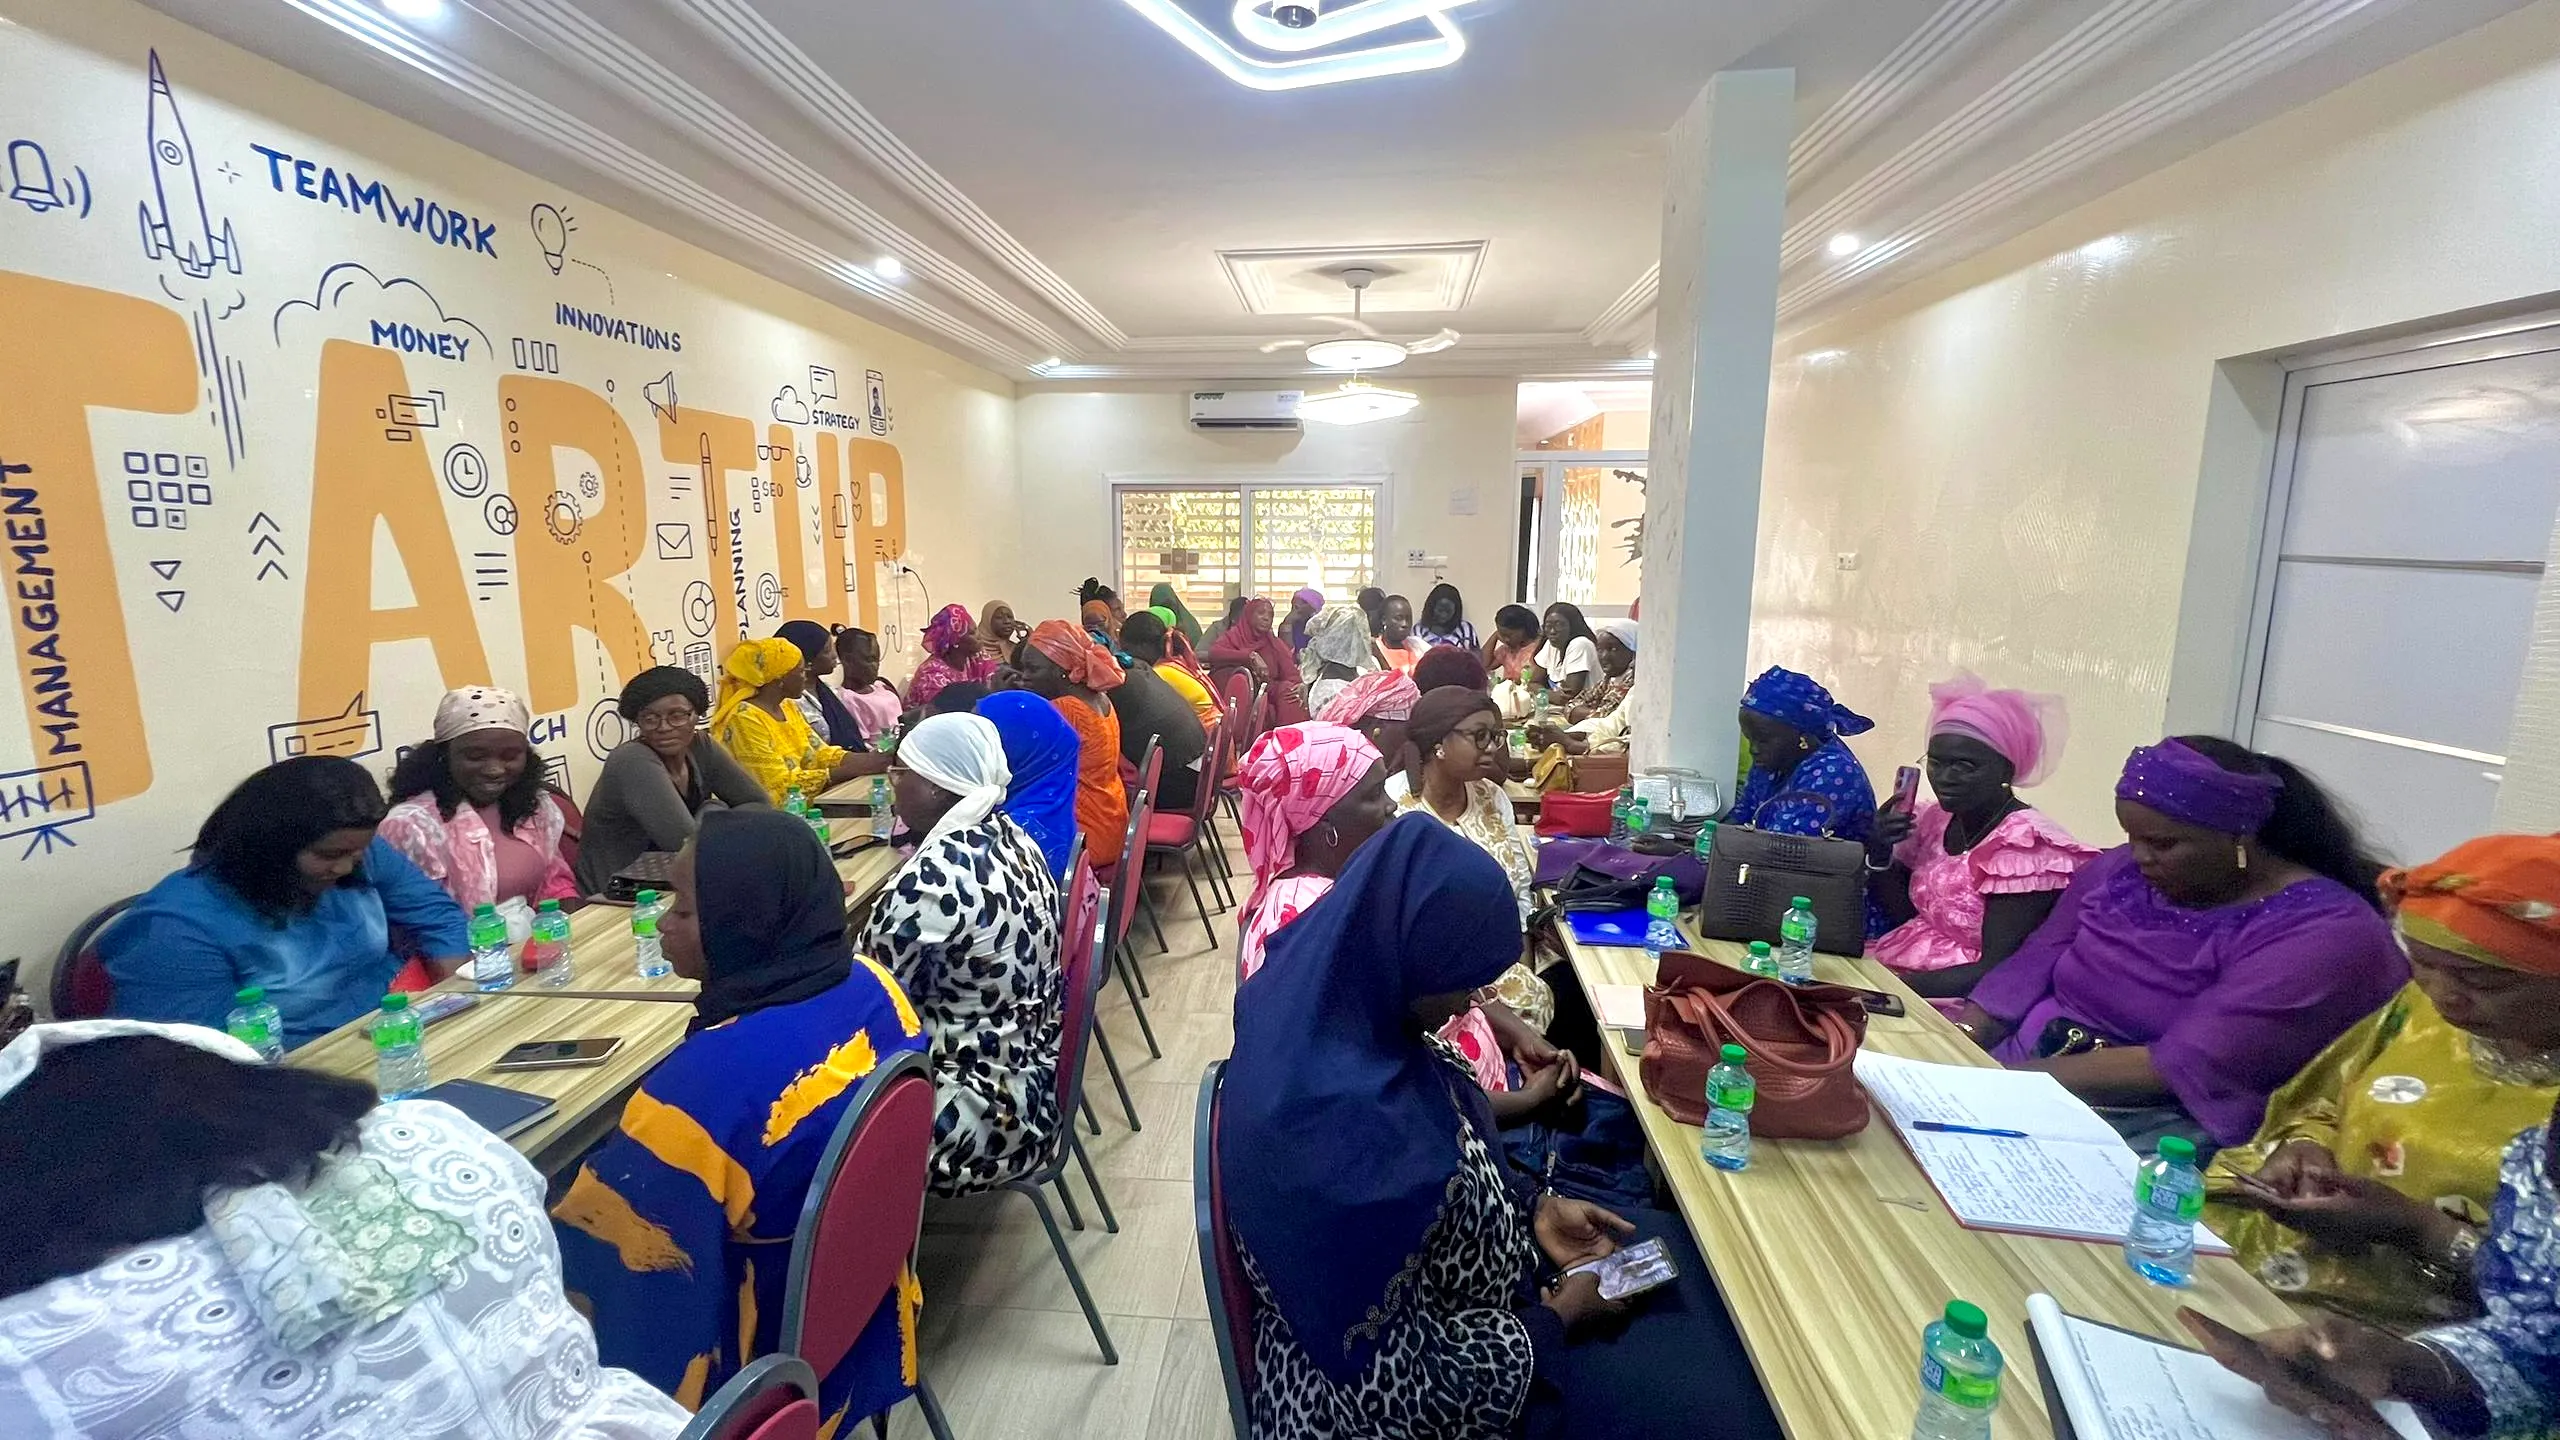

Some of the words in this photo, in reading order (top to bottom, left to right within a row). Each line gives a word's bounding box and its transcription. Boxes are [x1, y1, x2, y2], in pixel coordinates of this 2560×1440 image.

[249, 142, 499, 260] TEAMWORK
[369, 319, 470, 363] MONEY
[555, 301, 682, 353] INNOVATIONS
[811, 408, 861, 431] STRATEGY
[761, 480, 784, 498] SEO
[0, 458, 83, 756] MANAGEMENT
